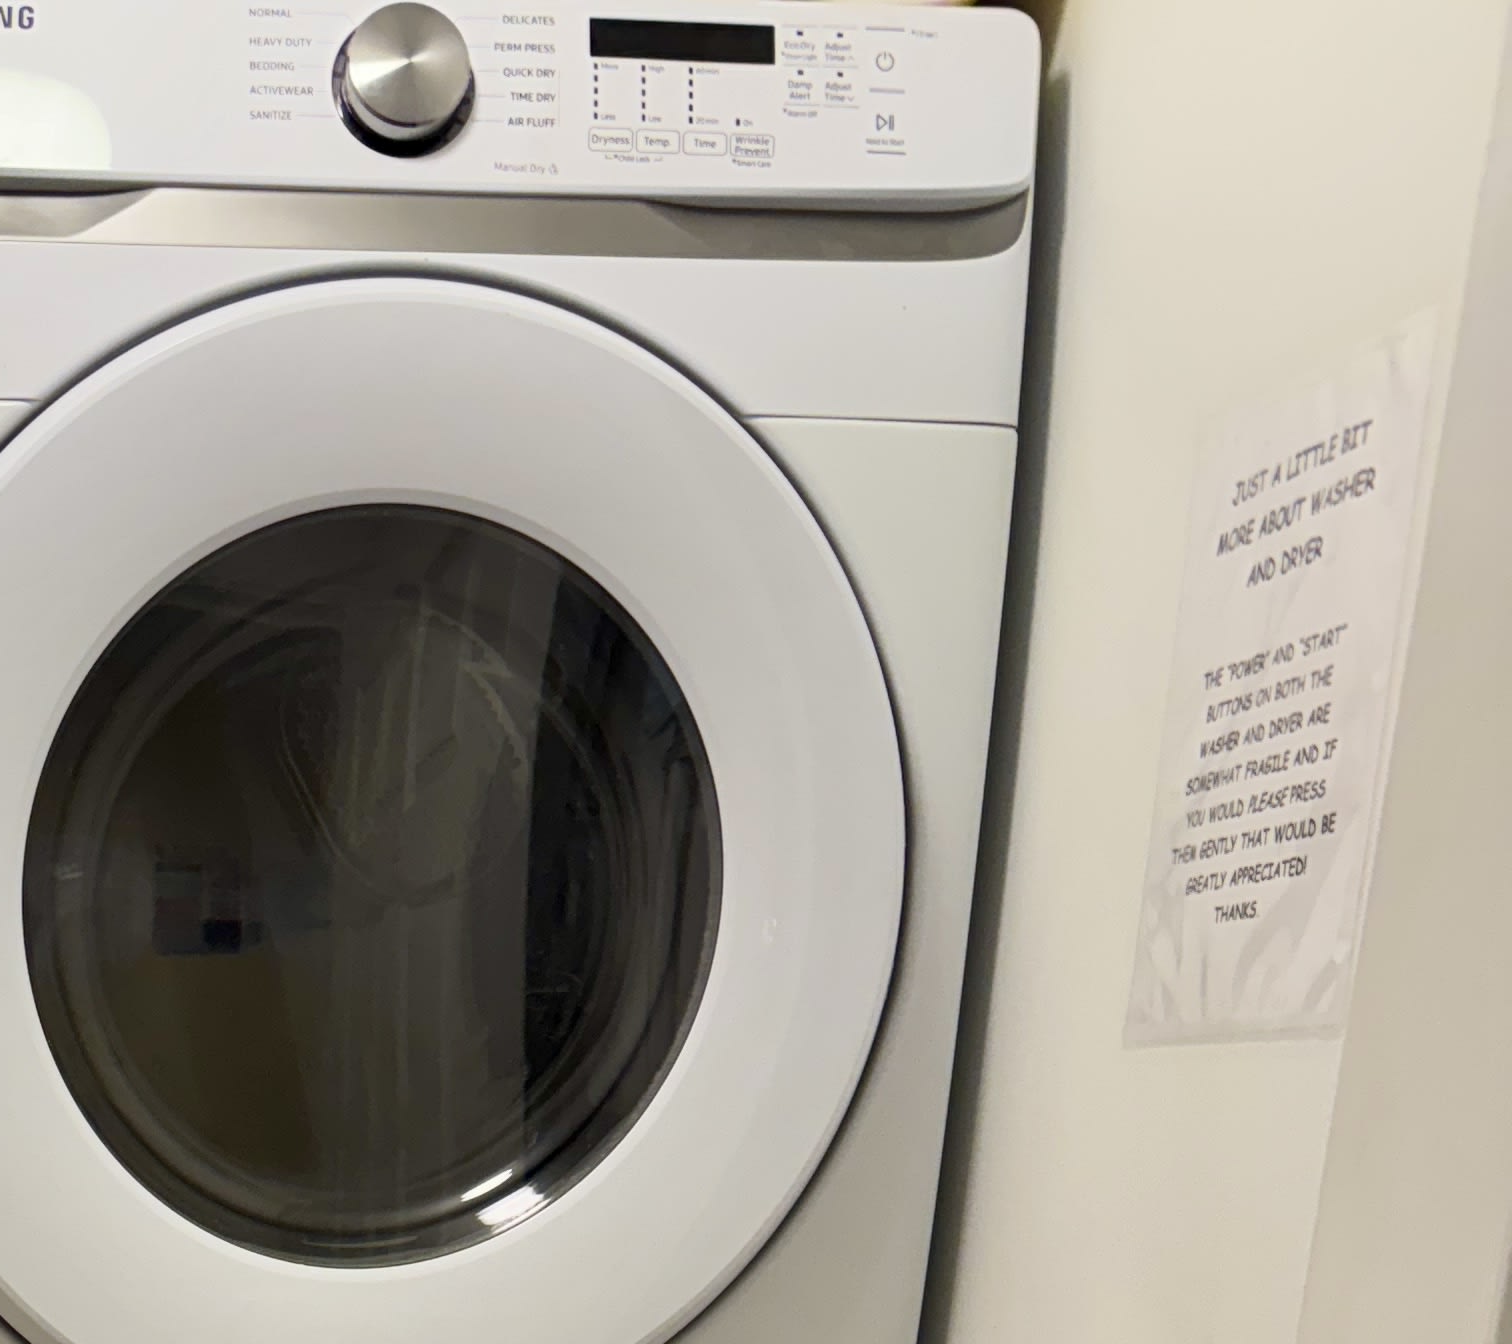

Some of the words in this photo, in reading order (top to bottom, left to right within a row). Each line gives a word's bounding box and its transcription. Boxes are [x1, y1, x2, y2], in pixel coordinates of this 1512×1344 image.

[248, 8, 291, 17] NORMAL
[502, 15, 556, 25] DELICATES
[249, 37, 283, 47] HEAVY
[285, 38, 312, 48] DUTY
[494, 42, 522, 52] PERM
[524, 43, 556, 54] PRESS
[249, 61, 295, 71] BEDDING
[503, 67, 533, 78] QUICK
[535, 69, 556, 78] DRY
[249, 85, 314, 96] ACTIVEWEAR
[510, 92, 533, 102] TIME
[536, 93, 556, 102] DRY
[249, 110, 292, 120] SANITIZE
[507, 117, 524, 126] AIR
[526, 117, 556, 128] FLUFF
[591, 134, 630, 146] Dryness
[693, 138, 717, 148] Time
[735, 136, 770, 146] Wrinkle
[1232, 470, 1268, 506] JUST
[1271, 464, 1281, 488] A
[1286, 433, 1338, 482] LITTLE
[1341, 419, 1373, 455] BIT
[1217, 519, 1255, 557] MORE
[1259, 497, 1306, 539] ABOUT
[1311, 467, 1376, 516] WASHER
[1246, 557, 1275, 588] AND
[1280, 536, 1323, 576] DRYER
[1204, 667, 1224, 691] THE
[1272, 643, 1295, 667] AND
[1206, 693, 1253, 724] BUTTONS
[1256, 687, 1272, 709] ON
[1274, 675, 1306, 701] BOTH
[1310, 664, 1334, 689] THE
[1200, 730, 1240, 759] WASHER
[1243, 723, 1265, 748] AND
[1269, 712, 1303, 743] DRYER
[1307, 702, 1332, 727] ARE
[1186, 764, 1242, 797] SOMEWHAT
[1244, 750, 1291, 781] FRAGILE
[1293, 743, 1319, 766] AND
[1322, 738, 1338, 761] IF
[1186, 807, 1205, 830] YOU
[1208, 799, 1244, 824] WOULD
[1247, 785, 1289, 815] PLEASE
[1290, 780, 1327, 804] PRESS
[1172, 844, 1197, 865] THEM
[1199, 834, 1238, 860] GENTLY
[1241, 827, 1271, 851] THAT
[1274, 818, 1317, 845] WOULD
[1321, 812, 1337, 835] BE
[1185, 868, 1226, 896] GREATLY
[1229, 855, 1308, 888] APPRECIATED!
